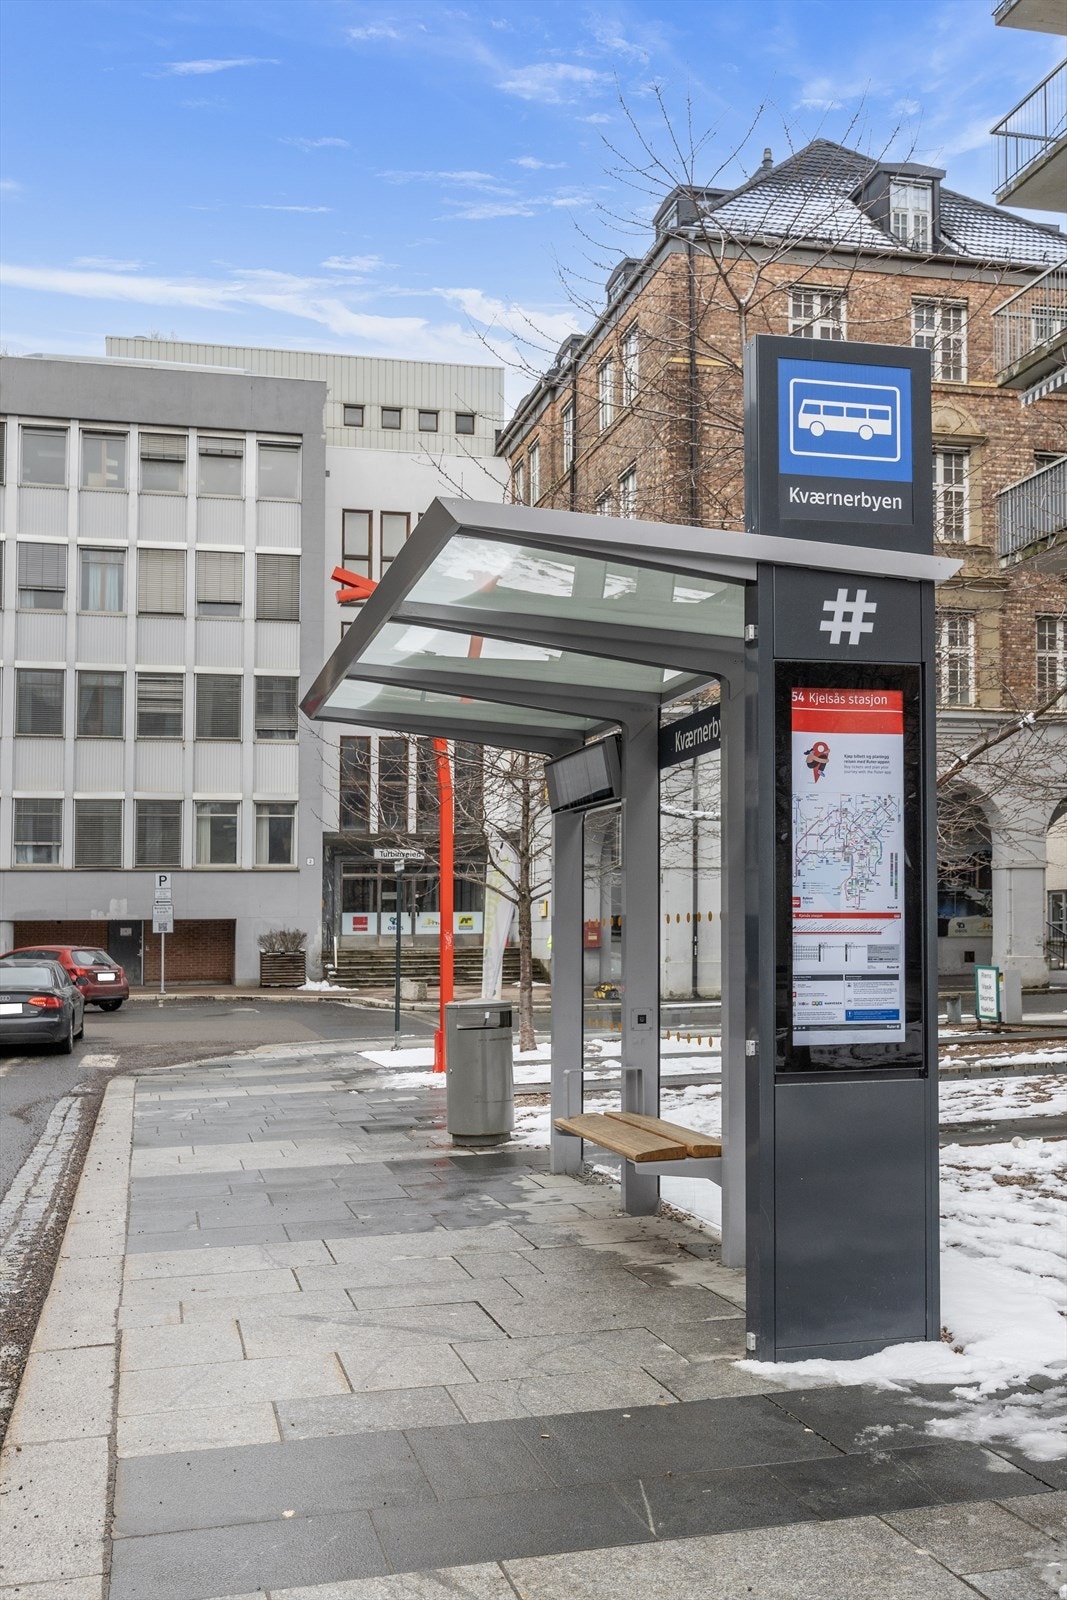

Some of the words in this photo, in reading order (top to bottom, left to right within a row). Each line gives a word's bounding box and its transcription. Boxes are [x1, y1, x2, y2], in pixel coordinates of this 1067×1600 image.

[789, 487, 902, 512] Kværnerbyen
[792, 691, 804, 703] 54
[809, 692, 846, 705] Kjelsås
[848, 694, 888, 706] stasjon
[159, 875, 167, 886] P
